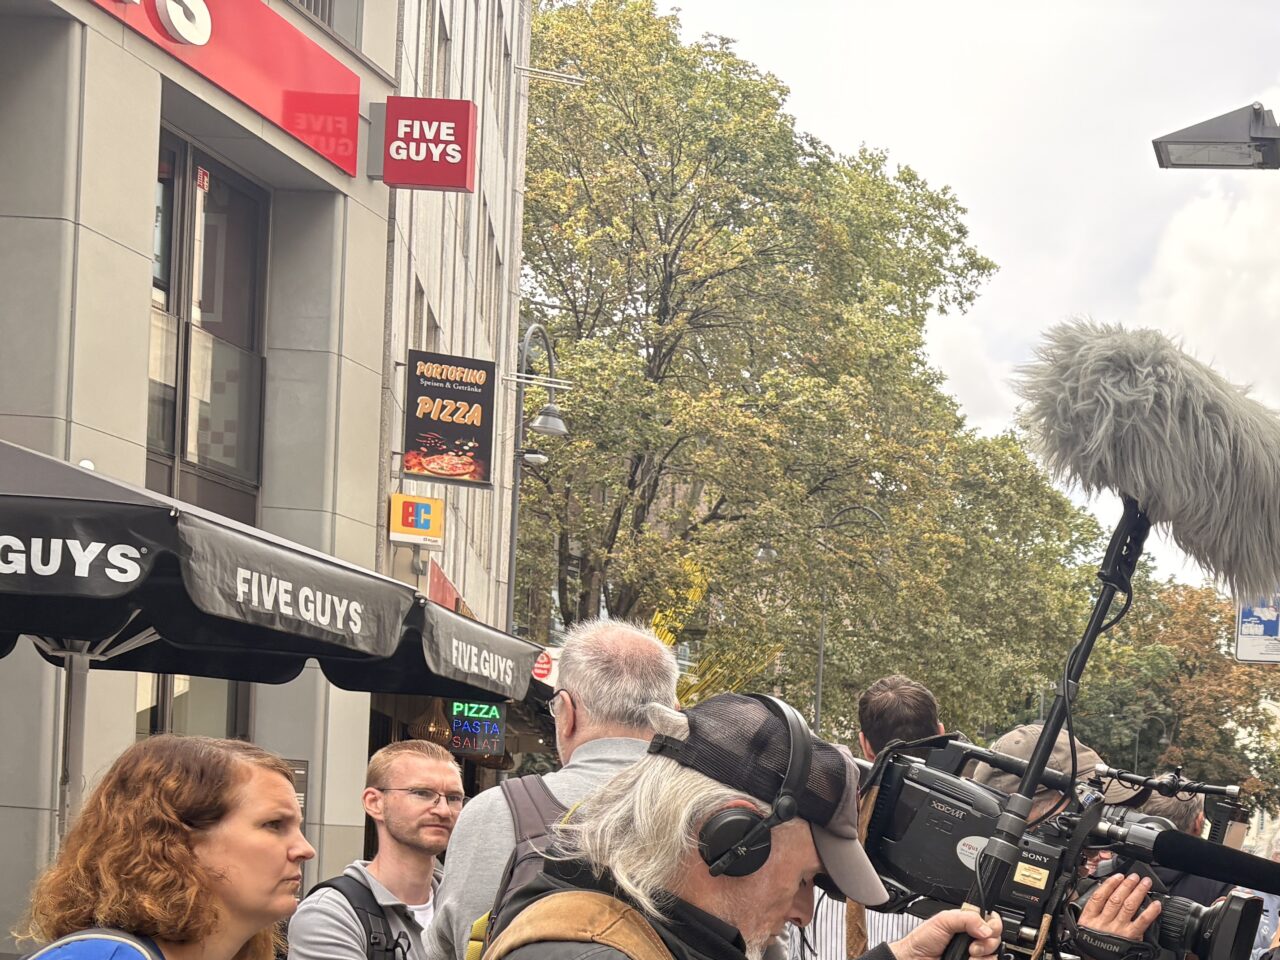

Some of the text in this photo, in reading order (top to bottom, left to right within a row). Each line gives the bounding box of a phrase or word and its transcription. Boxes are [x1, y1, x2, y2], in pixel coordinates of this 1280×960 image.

[397, 120, 455, 141] FIVE
[389, 141, 462, 163] GUYS
[416, 361, 487, 385] PORTOFINO
[420, 378, 444, 388] Speisen
[453, 383, 482, 393] Getränke
[416, 396, 482, 427] PIZZA
[236, 567, 293, 615] FIVE
[452, 638, 479, 675] FIVE
[480, 650, 513, 685] GUYS
[452, 701, 500, 719] PIZZA
[453, 719, 500, 735] PASTA
[452, 736, 500, 751] SALAT
[1021, 850, 1050, 863] SONY
[1082, 933, 1120, 953] FUJINON
